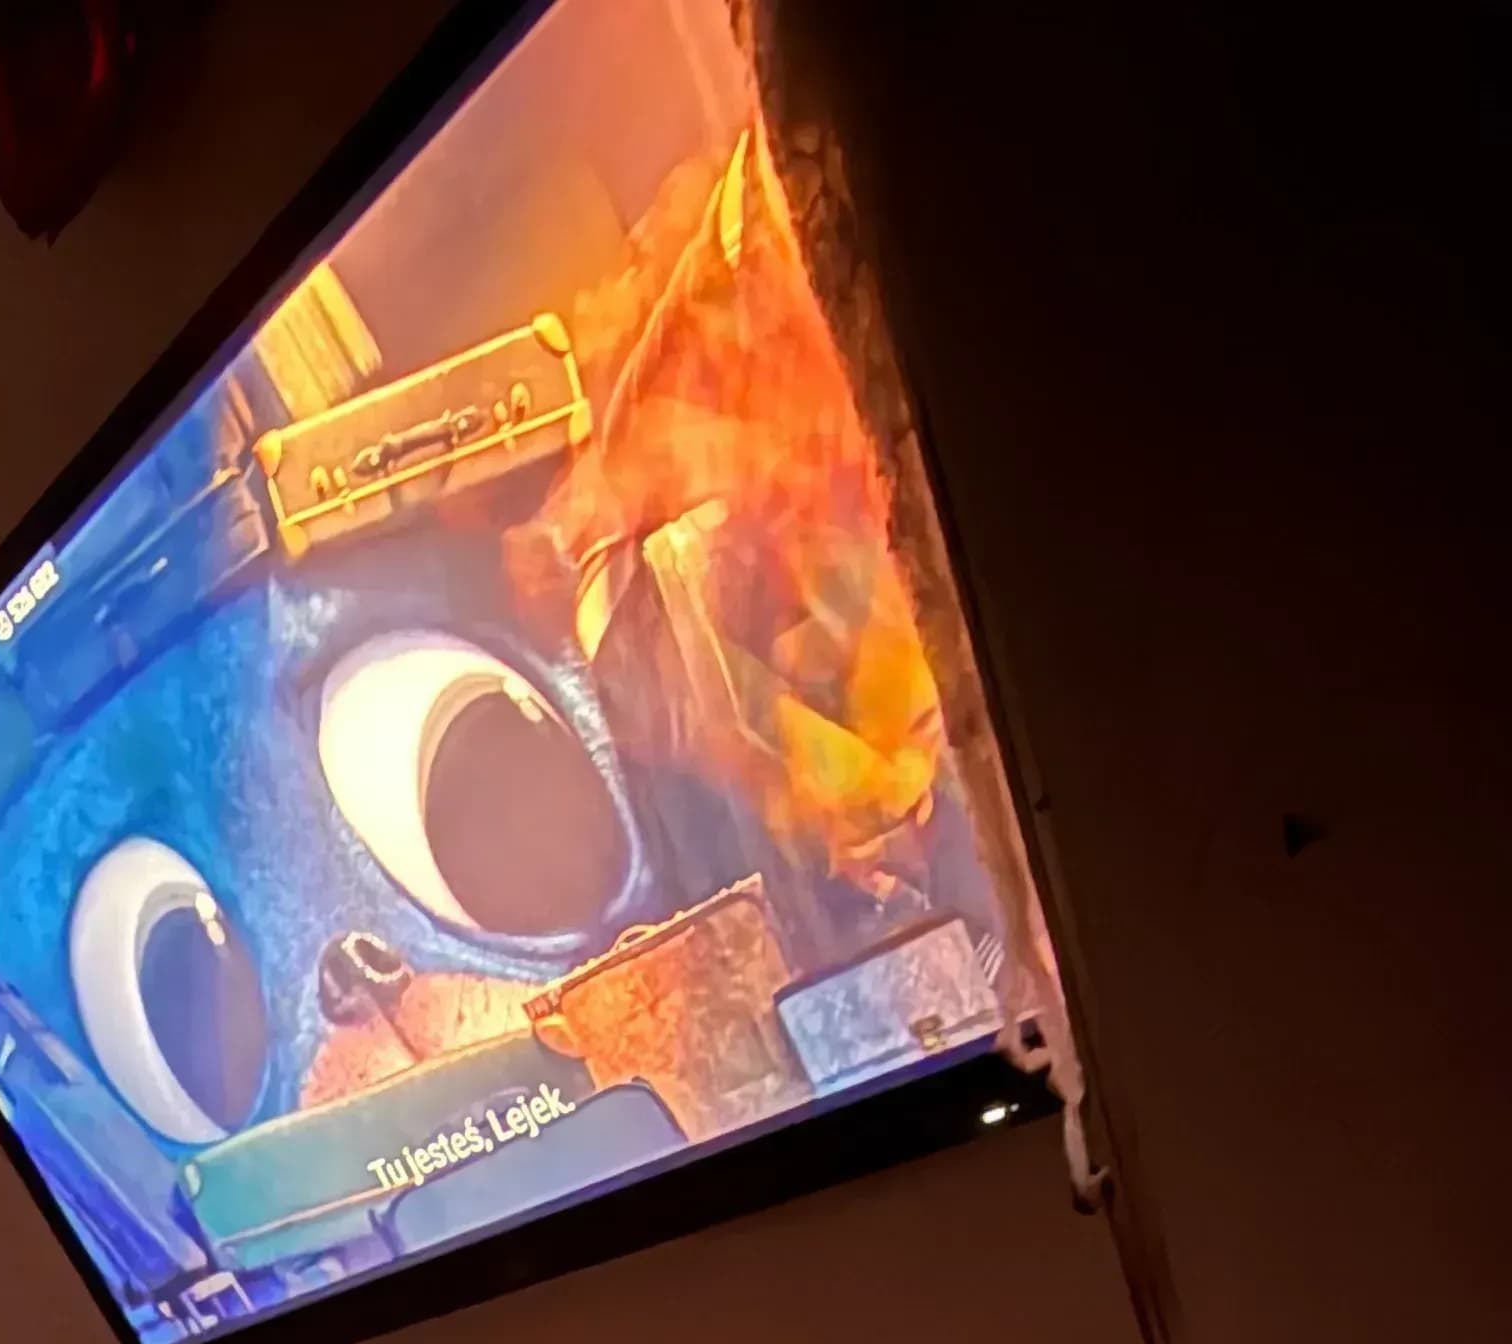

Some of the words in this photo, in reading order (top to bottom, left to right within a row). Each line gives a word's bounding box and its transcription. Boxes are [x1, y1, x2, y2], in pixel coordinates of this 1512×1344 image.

[366, 1154, 409, 1190] Tu
[402, 1117, 495, 1187] jesteś,
[486, 1083, 576, 1142] Lejek.
